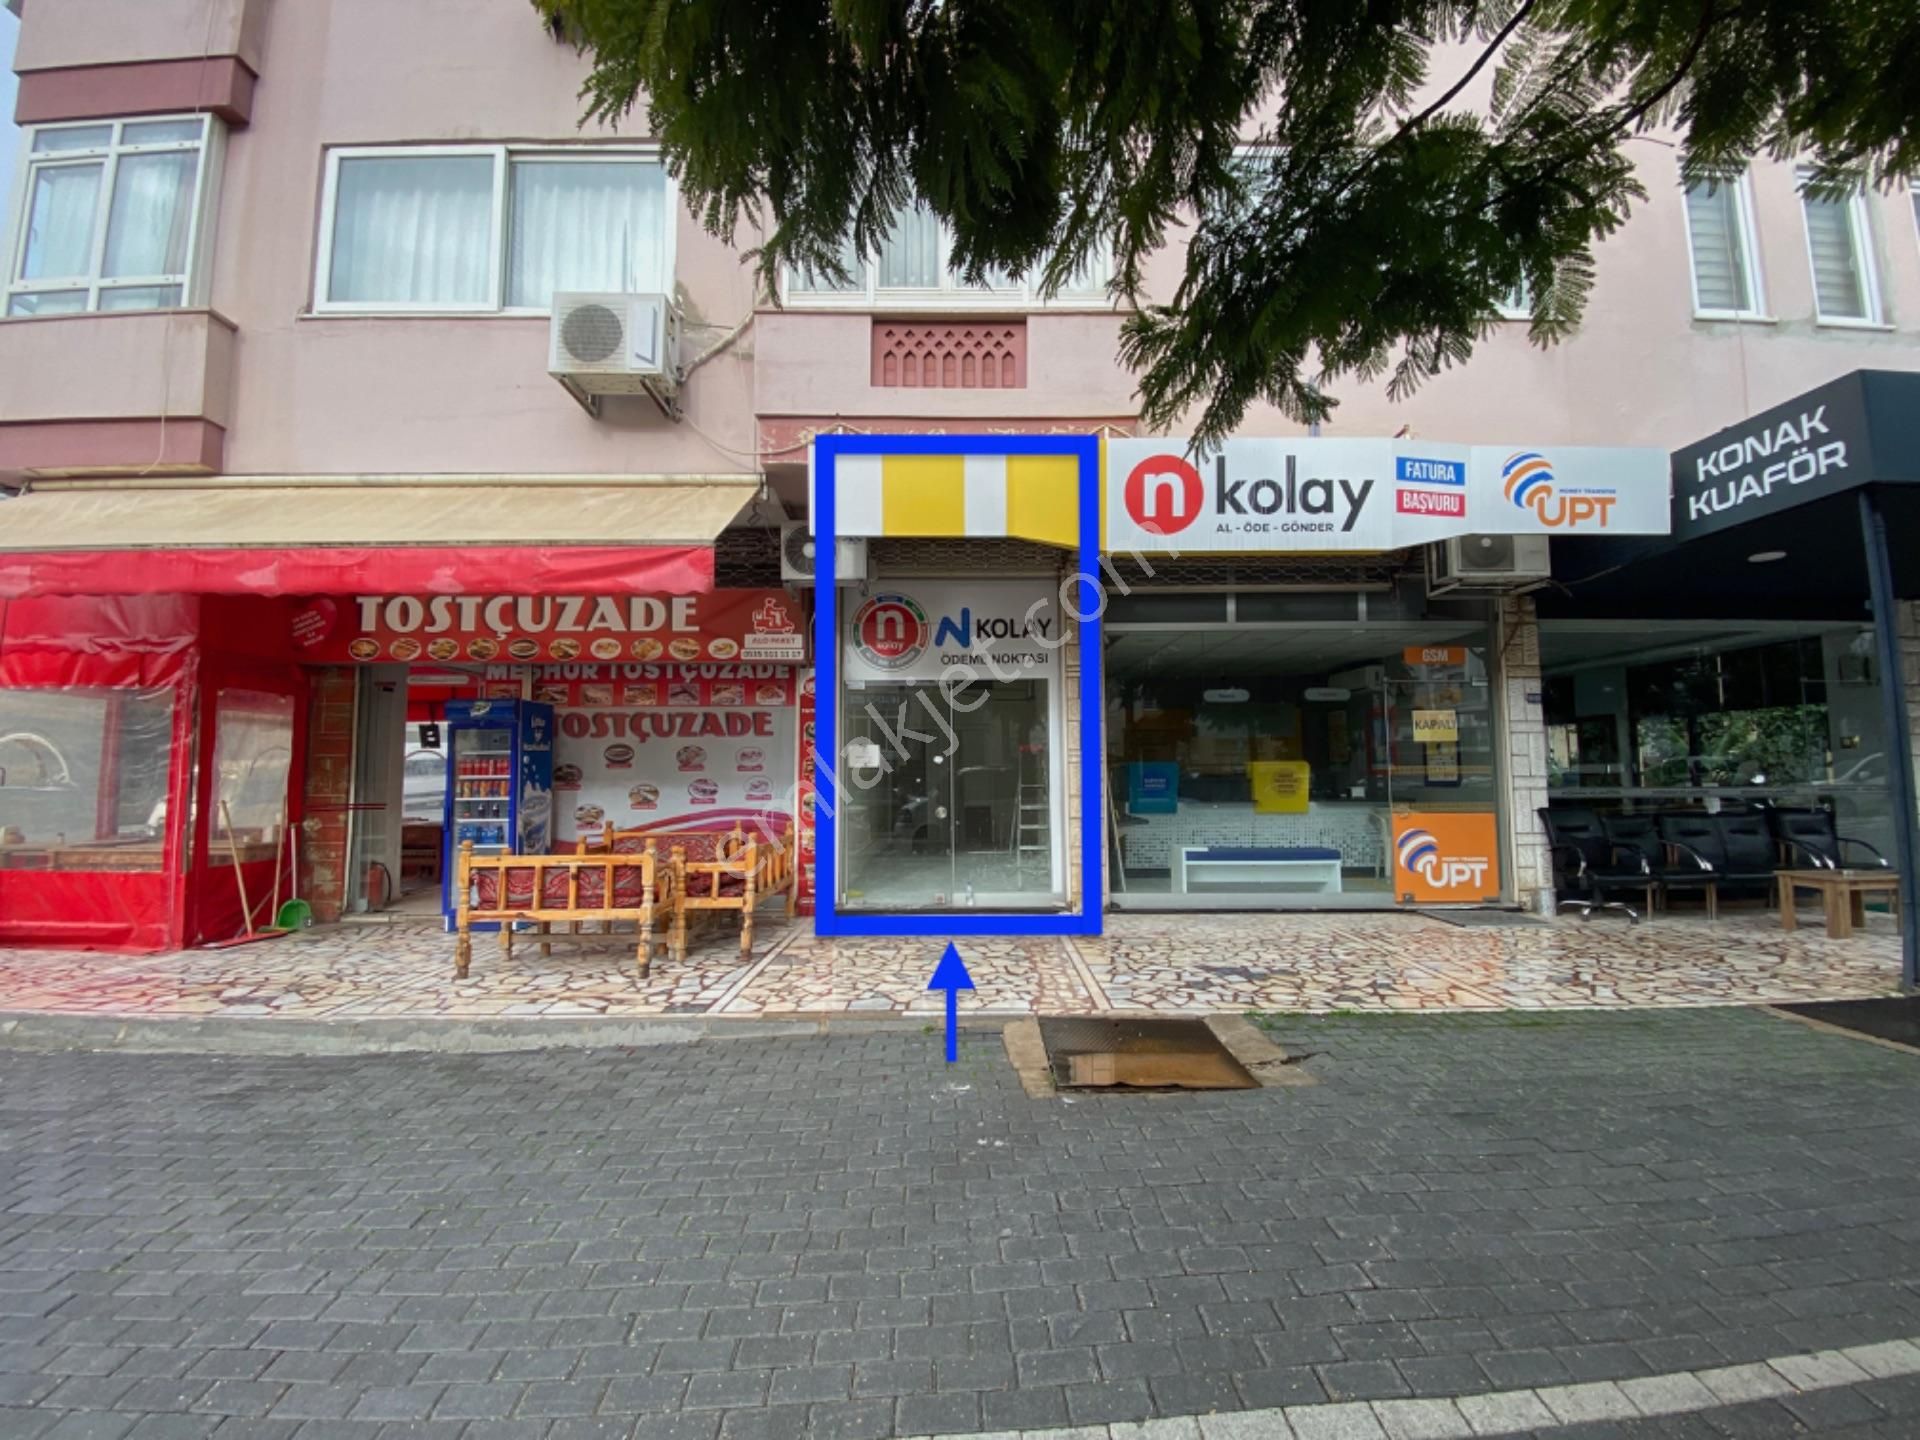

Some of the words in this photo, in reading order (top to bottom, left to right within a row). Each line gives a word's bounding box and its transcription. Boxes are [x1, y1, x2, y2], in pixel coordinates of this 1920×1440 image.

[1697, 405, 1829, 482] KONAK
[1405, 461, 1456, 482] FATURA
[1689, 441, 1848, 520] KUAFÖR
[1216, 455, 1374, 532] kolay
[1403, 491, 1459, 513] BAŞVURU
[1537, 496, 1616, 527] UPT
[1216, 523, 1233, 532] AL
[1243, 522, 1269, 532] ÖDE
[1281, 521, 1334, 532] GÖNDER
[356, 595, 699, 640] TOSTÇUZADE
[976, 618, 1052, 639] KOLAY
[992, 653, 1048, 664] NOKTASI
[1422, 648, 1448, 662] GSM
[1426, 863, 1488, 888] UPT
